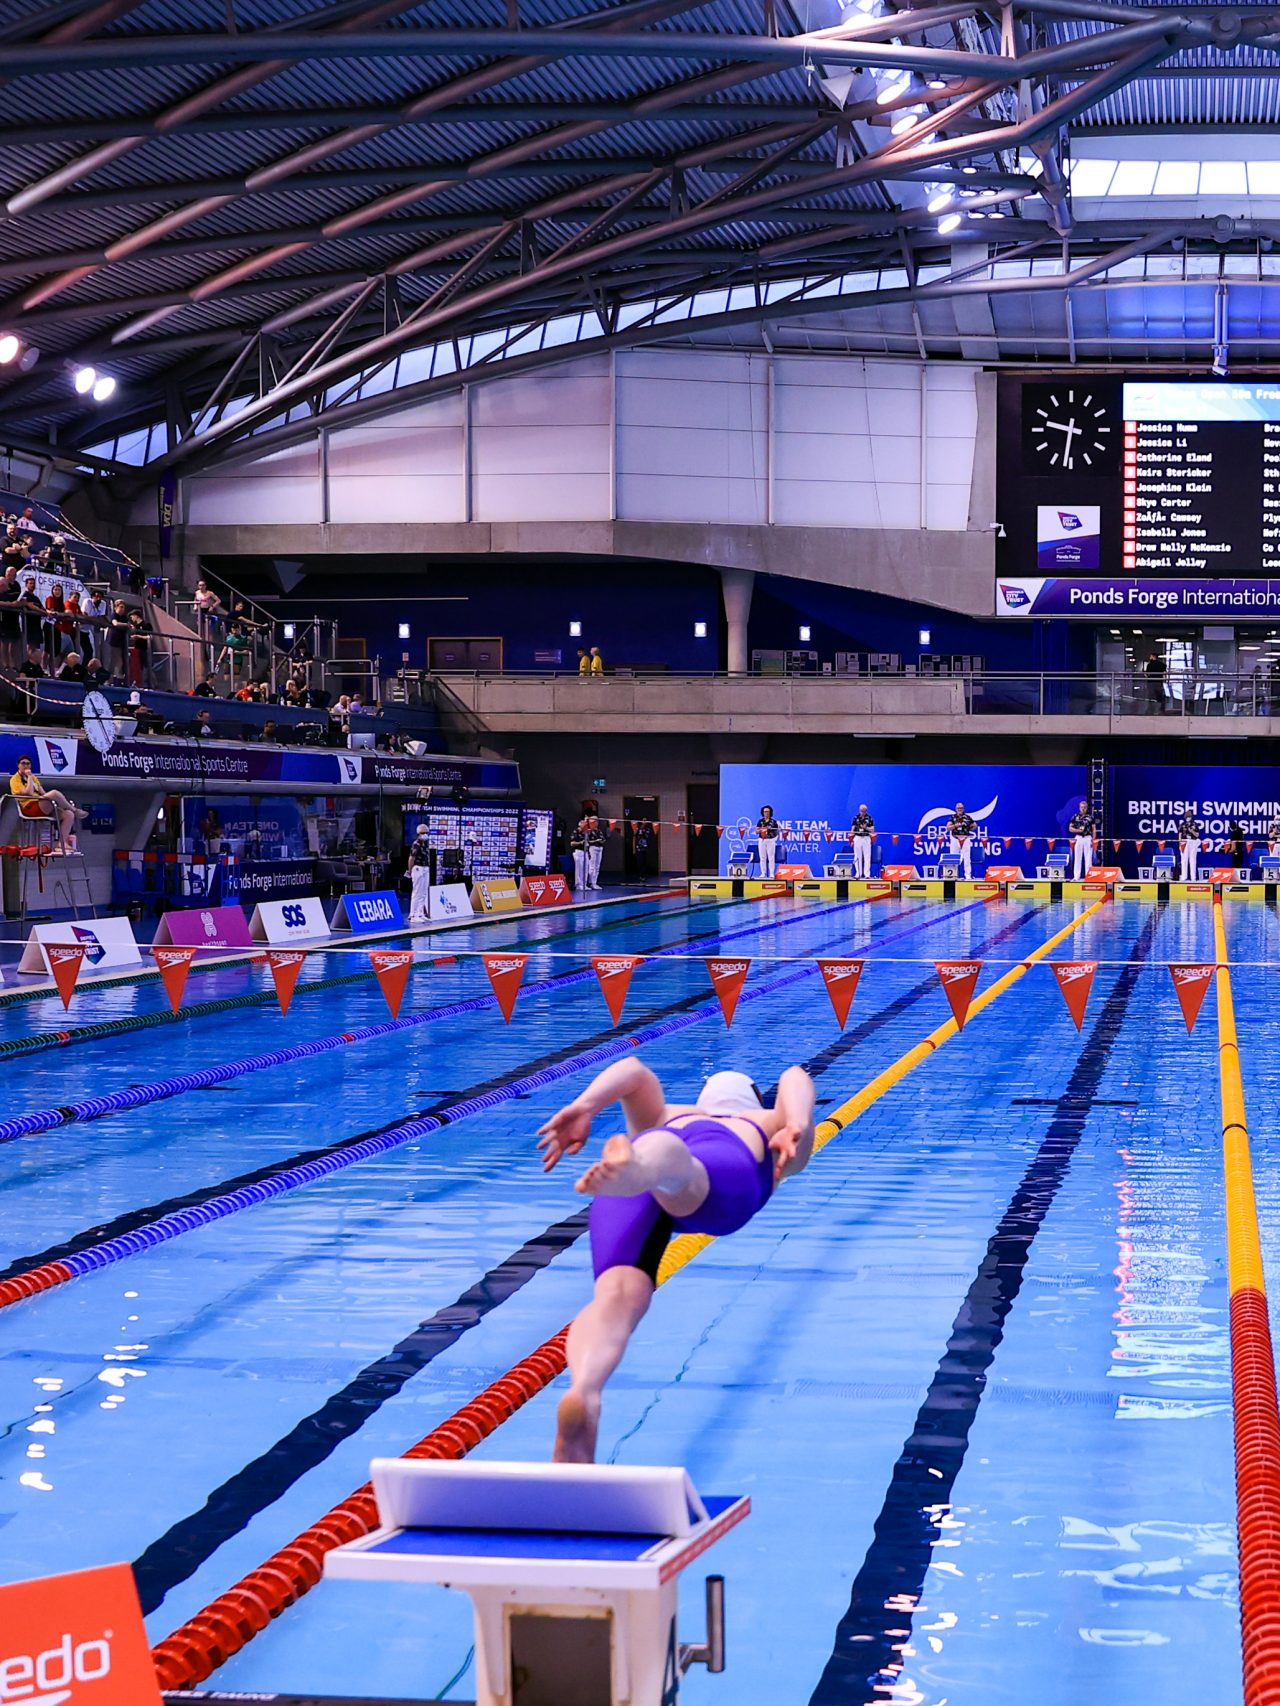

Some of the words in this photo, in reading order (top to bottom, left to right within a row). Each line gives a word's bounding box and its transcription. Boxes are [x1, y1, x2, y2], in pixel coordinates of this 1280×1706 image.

[1137, 424, 1172, 432] Jessica
[1137, 438, 1172, 447] Jessica
[1177, 439, 1187, 447] Li
[1136, 453, 1182, 462] Catherine
[1186, 453, 1212, 462] Eland
[1137, 483, 1182, 493] Josephine
[1186, 483, 1212, 492] Klein
[1136, 498, 1157, 508] Skye
[1161, 498, 1191, 507] Carter
[1136, 528, 1177, 537] Isabella
[1181, 528, 1206, 537] Jones
[1136, 543, 1157, 552] Drew
[1263, 543, 1274, 552] Co
[1135, 558, 1171, 568] Abigail
[1175, 558, 1206, 568] Jolley
[1070, 587, 1124, 605] Ponds
[1128, 588, 1179, 609] Forge
[102, 750, 129, 768] Ponds
[129, 752, 153, 773] Forge
[201, 755, 226, 775] Sports
[226, 757, 249, 773] Centre
[1128, 801, 1197, 815] BRITISH
[795, 820, 832, 830] TEAM.
[252, 873, 273, 891] Forge
[272, 869, 313, 887] International
[281, 903, 307, 928] SOS
[353, 898, 394, 923] LEBARA
[50, 947, 83, 957] speedo
[158, 950, 193, 960] speedo
[270, 951, 303, 961] speedo
[374, 954, 410, 964] speedo
[488, 958, 524, 969] speedo
[597, 959, 633, 970] speedo
[711, 961, 747, 972] speedo
[824, 964, 860, 974] speedo
[941, 964, 978, 974] speedo
[1057, 964, 1093, 975] speedo
[1174, 966, 1211, 977] speedo
